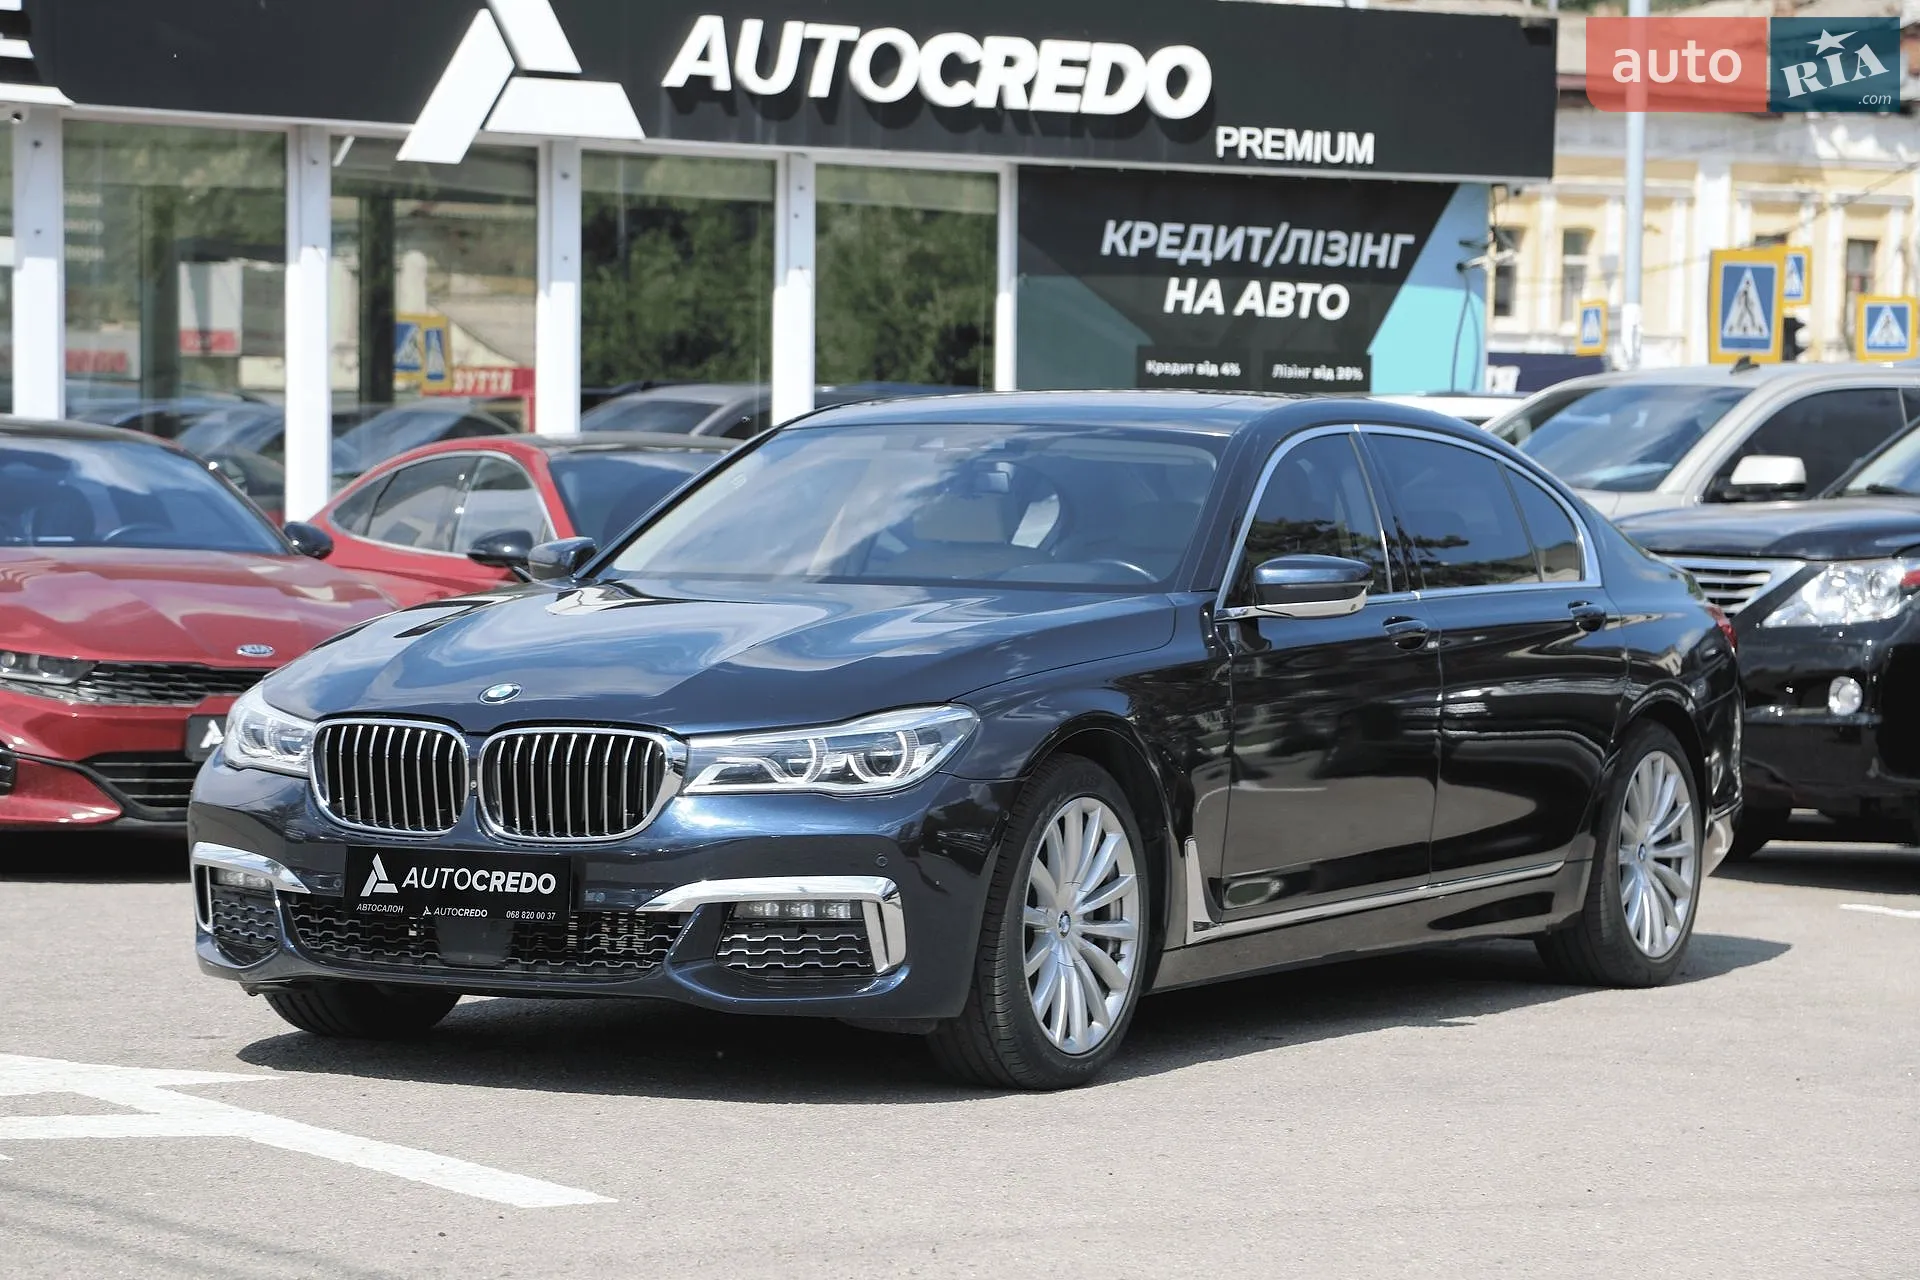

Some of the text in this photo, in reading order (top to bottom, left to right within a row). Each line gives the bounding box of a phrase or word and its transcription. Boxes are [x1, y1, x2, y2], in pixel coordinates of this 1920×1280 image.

[662, 15, 1212, 119] AUTOCREDO
[1216, 125, 1375, 165] PREMIUM
[1101, 219, 1415, 269] КРЕДИТ/ЛІЗІНГ
[1163, 277, 1351, 321] НА АВТО
[1145, 360, 1241, 377] Кредит від 4%
[1272, 364, 1311, 379] Лізінг
[1312, 364, 1335, 381] від
[402, 867, 556, 895] AUTOCREDO
[356, 903, 404, 914] АВТОСАЛОН
[434, 907, 488, 918] AUTOCREDO
[506, 910, 556, 920] 068 820 00 37
